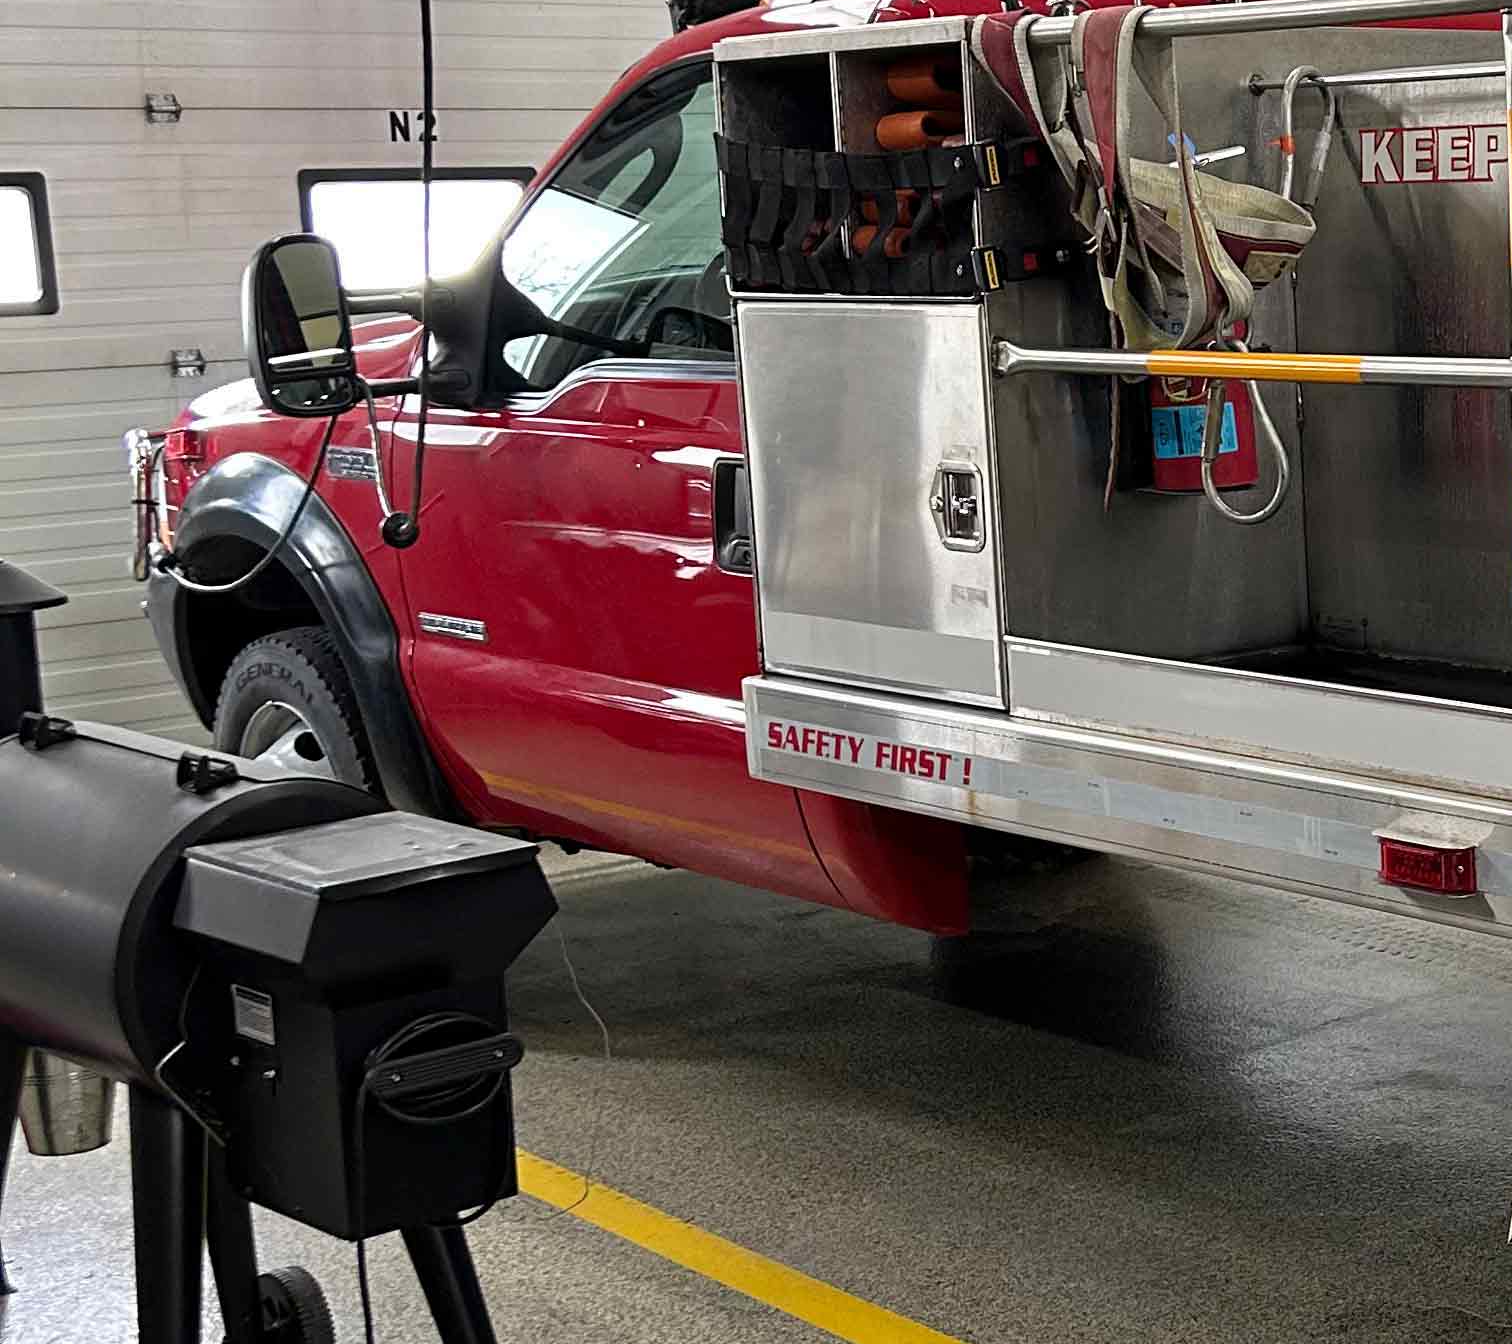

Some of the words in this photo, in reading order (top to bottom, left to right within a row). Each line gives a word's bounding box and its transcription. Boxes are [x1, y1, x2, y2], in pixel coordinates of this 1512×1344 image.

[389, 111, 438, 142] N2
[1359, 123, 1509, 184] KEEP
[875, 741, 952, 781] FIRST
